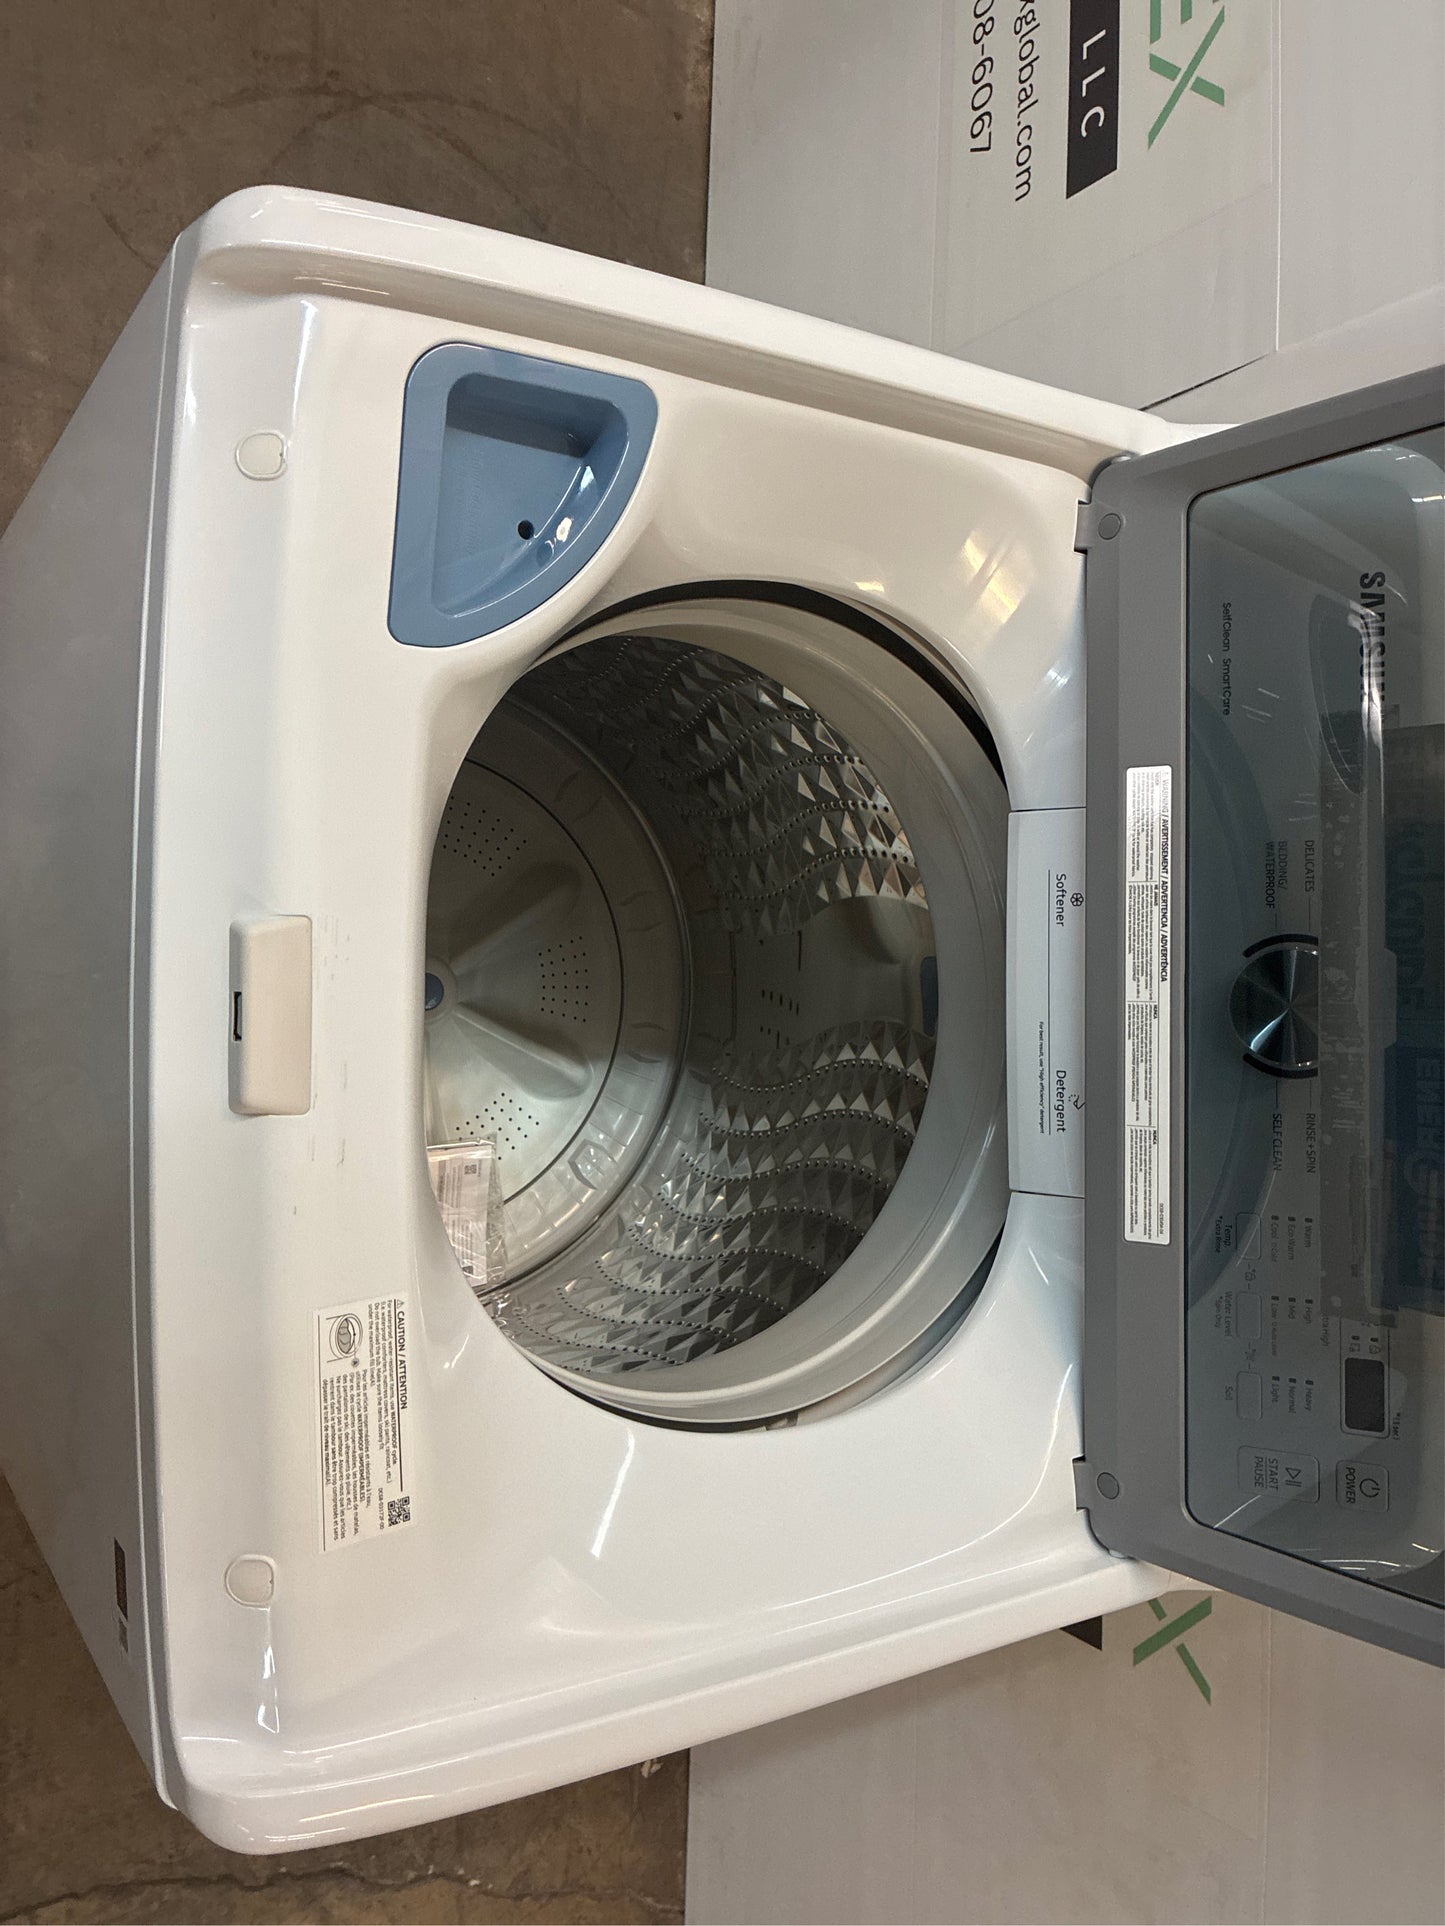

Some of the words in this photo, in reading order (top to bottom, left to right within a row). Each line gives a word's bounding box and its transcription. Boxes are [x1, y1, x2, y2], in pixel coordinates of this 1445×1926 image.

[970, 0, 995, 153] 08-6067
[1080, 29, 1106, 138] LLC
[1222, 602, 1233, 652] SelfClean
[1360, 571, 1386, 708] SAMSUN
[1222, 658, 1232, 716] SmartCare
[1161, 818, 1169, 875] AVERTISSEMENT
[1278, 841, 1288, 890] BEDDING/
[1304, 840, 1315, 893] DELICATES
[1055, 873, 1066, 926] Softener
[1265, 841, 1276, 909] WATERPROOF
[1160, 880, 1168, 929] ADVERTENCIA
[1160, 934, 1169, 983] ADVERTÊNCIA
[1054, 1070, 1066, 1132] Detergent
[1273, 1113, 1283, 1136] SELF
[1273, 1138, 1283, 1171] CLEAN
[1305, 1225, 1313, 1248] Warm
[1224, 1291, 1233, 1313] Water
[1225, 1315, 1233, 1337] Level
[1288, 1305, 1296, 1319] Mid
[1304, 1307, 1313, 1324] High
[397, 1311, 405, 1351] CAUTION
[398, 1359, 407, 1410] ATTENTION
[1288, 1386, 1296, 1414] Normal
[1255, 1456, 1264, 1489] PAUSE
[1268, 1458, 1278, 1492] START
[1346, 1467, 1356, 1504] POWER
